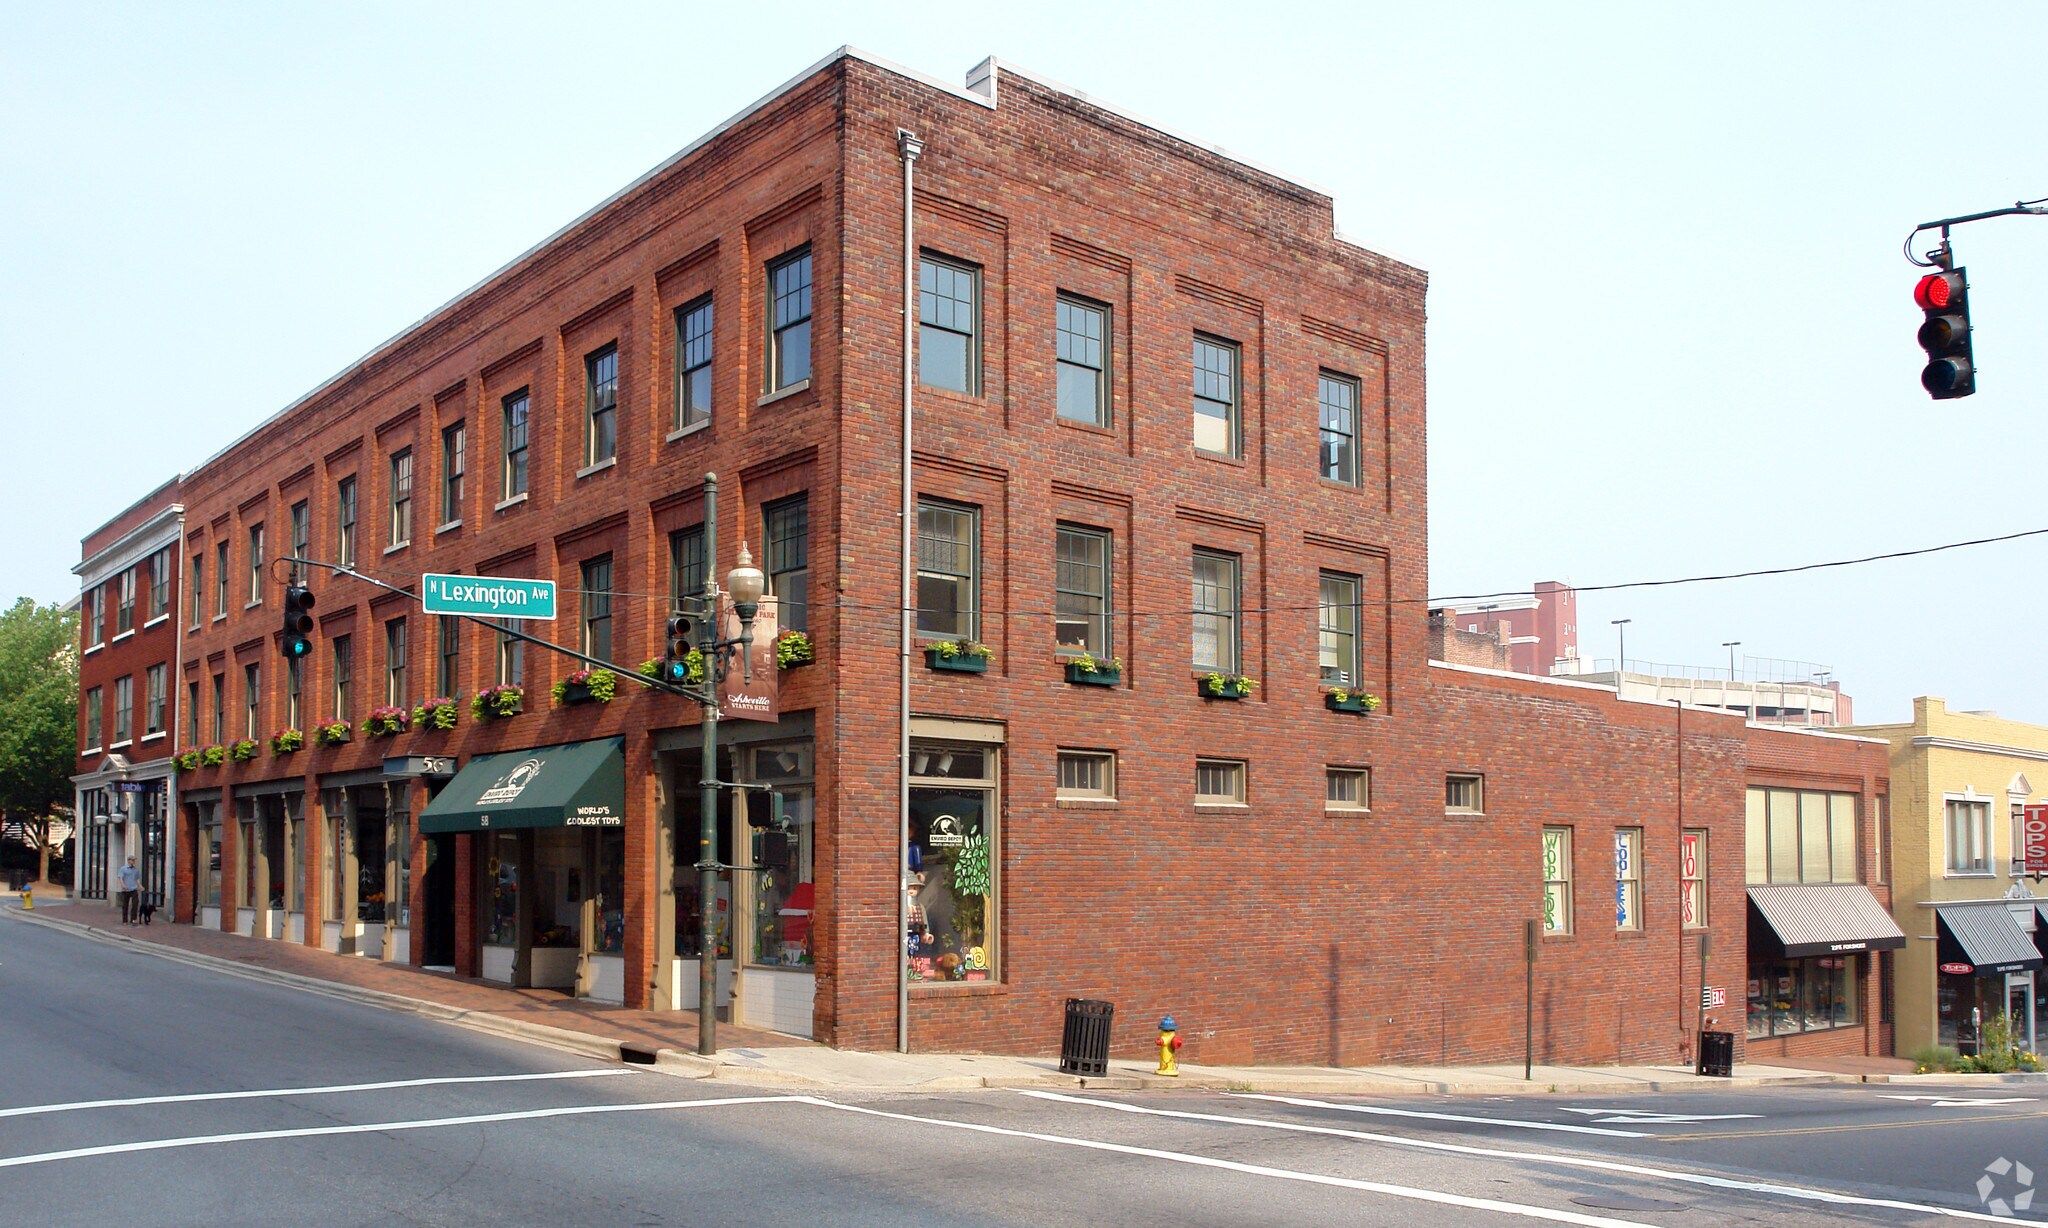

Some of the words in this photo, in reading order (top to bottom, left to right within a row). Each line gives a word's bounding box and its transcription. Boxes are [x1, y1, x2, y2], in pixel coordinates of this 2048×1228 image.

[430, 580, 437, 593] N
[441, 581, 527, 609] Lexington
[532, 587, 549, 600] Ave
[728, 693, 770, 705] Asheville
[423, 757, 446, 772] 56
[577, 806, 610, 815] WORLD'S
[481, 815, 489, 826] 58
[566, 817, 600, 825] COOLEST
[602, 816, 620, 825] TOYS
[2025, 807, 2047, 858] TOPS
[1683, 836, 1697, 923] TOYS
